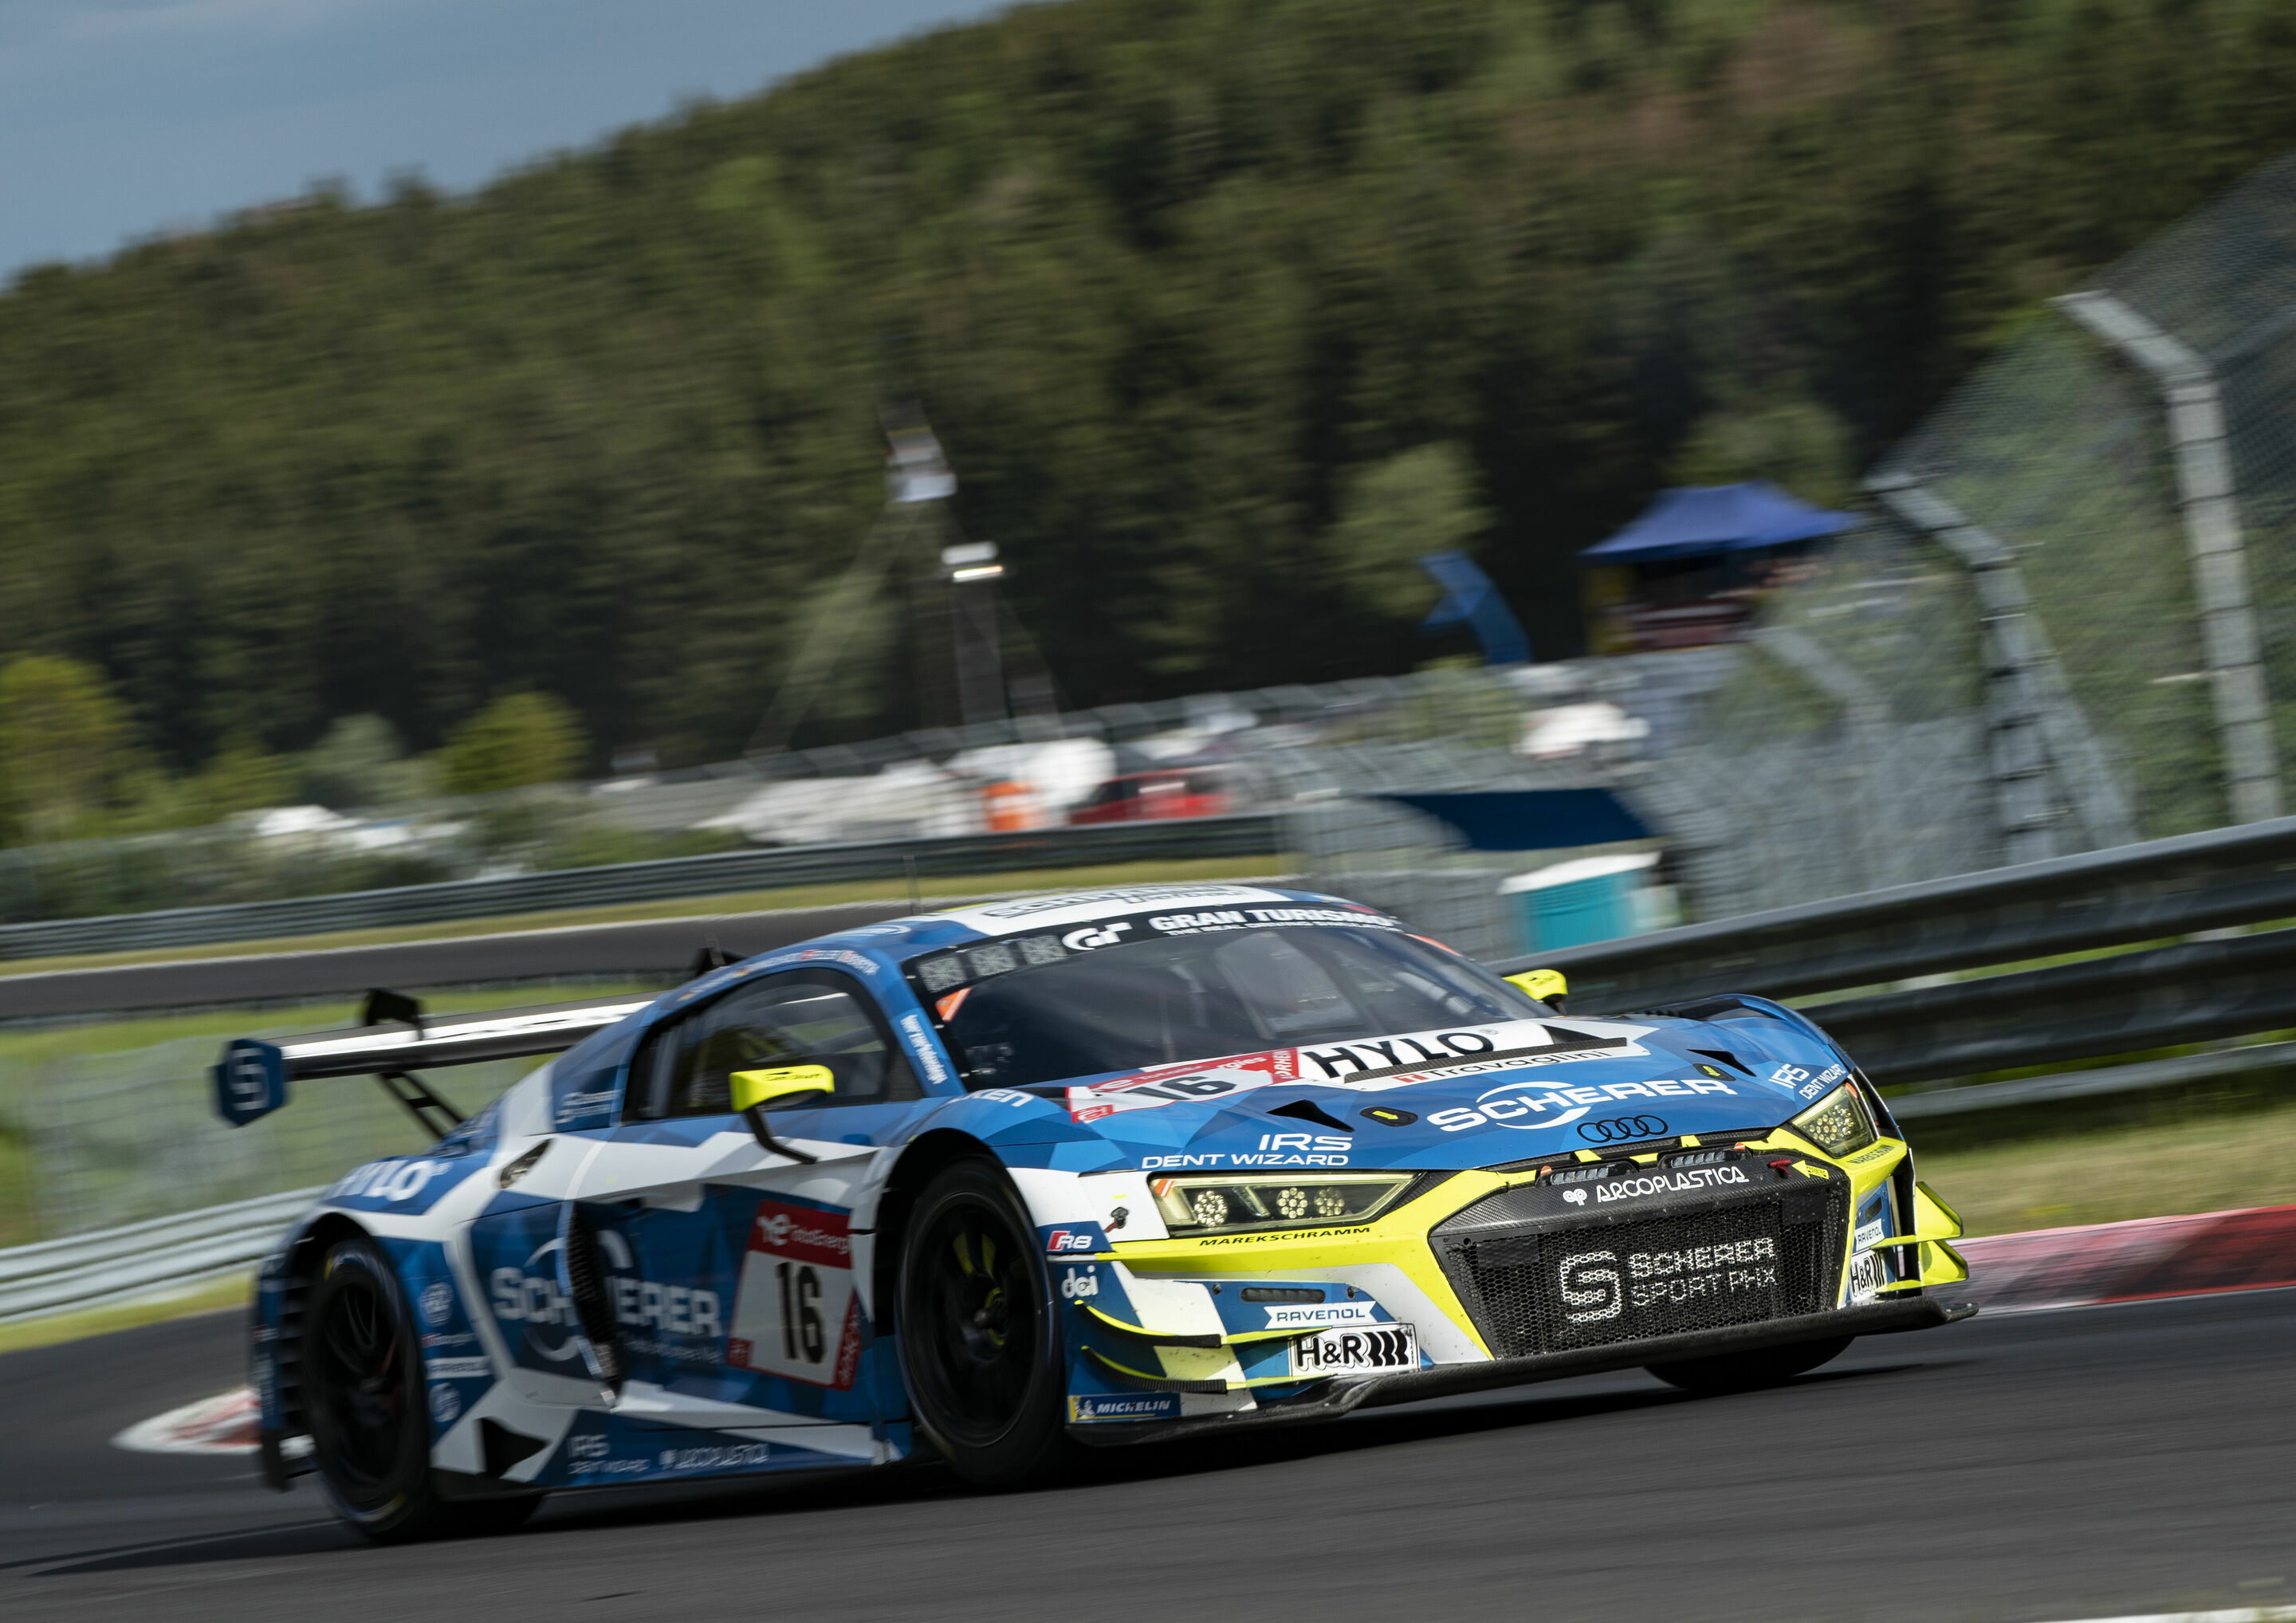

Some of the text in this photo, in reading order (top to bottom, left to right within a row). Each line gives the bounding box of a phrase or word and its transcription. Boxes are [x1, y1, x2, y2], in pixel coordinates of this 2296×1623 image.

[1148, 908, 1402, 931] GRAN TURISMO
[1302, 1032, 1494, 1079] HYLO
[1421, 1049, 1614, 1078] Travaglini
[1769, 1063, 1810, 1089] IRS
[1799, 1076, 1826, 1101] DENT
[1426, 1079, 1738, 1132] SCHERER
[1258, 1133, 1354, 1152] IRS
[1141, 1153, 1350, 1170] DENT WIZARD
[1595, 1165, 1750, 1204] ARCOPLASTICA
[1054, 1233, 1094, 1250] R8
[1198, 1226, 1371, 1247] MAREKSCHRAMM
[1857, 1226, 1882, 1244] RAVENOL
[1628, 1236, 1778, 1279] SCHERER
[1559, 1250, 1623, 1323] S
[1631, 1272, 1722, 1308] SPORT
[1850, 1257, 1874, 1296] H&R
[776, 1261, 824, 1365] 16
[1276, 1308, 1366, 1322] RAVENOL
[1295, 1333, 1366, 1371] H&R
[1096, 1398, 1172, 1413] MICHELIN
